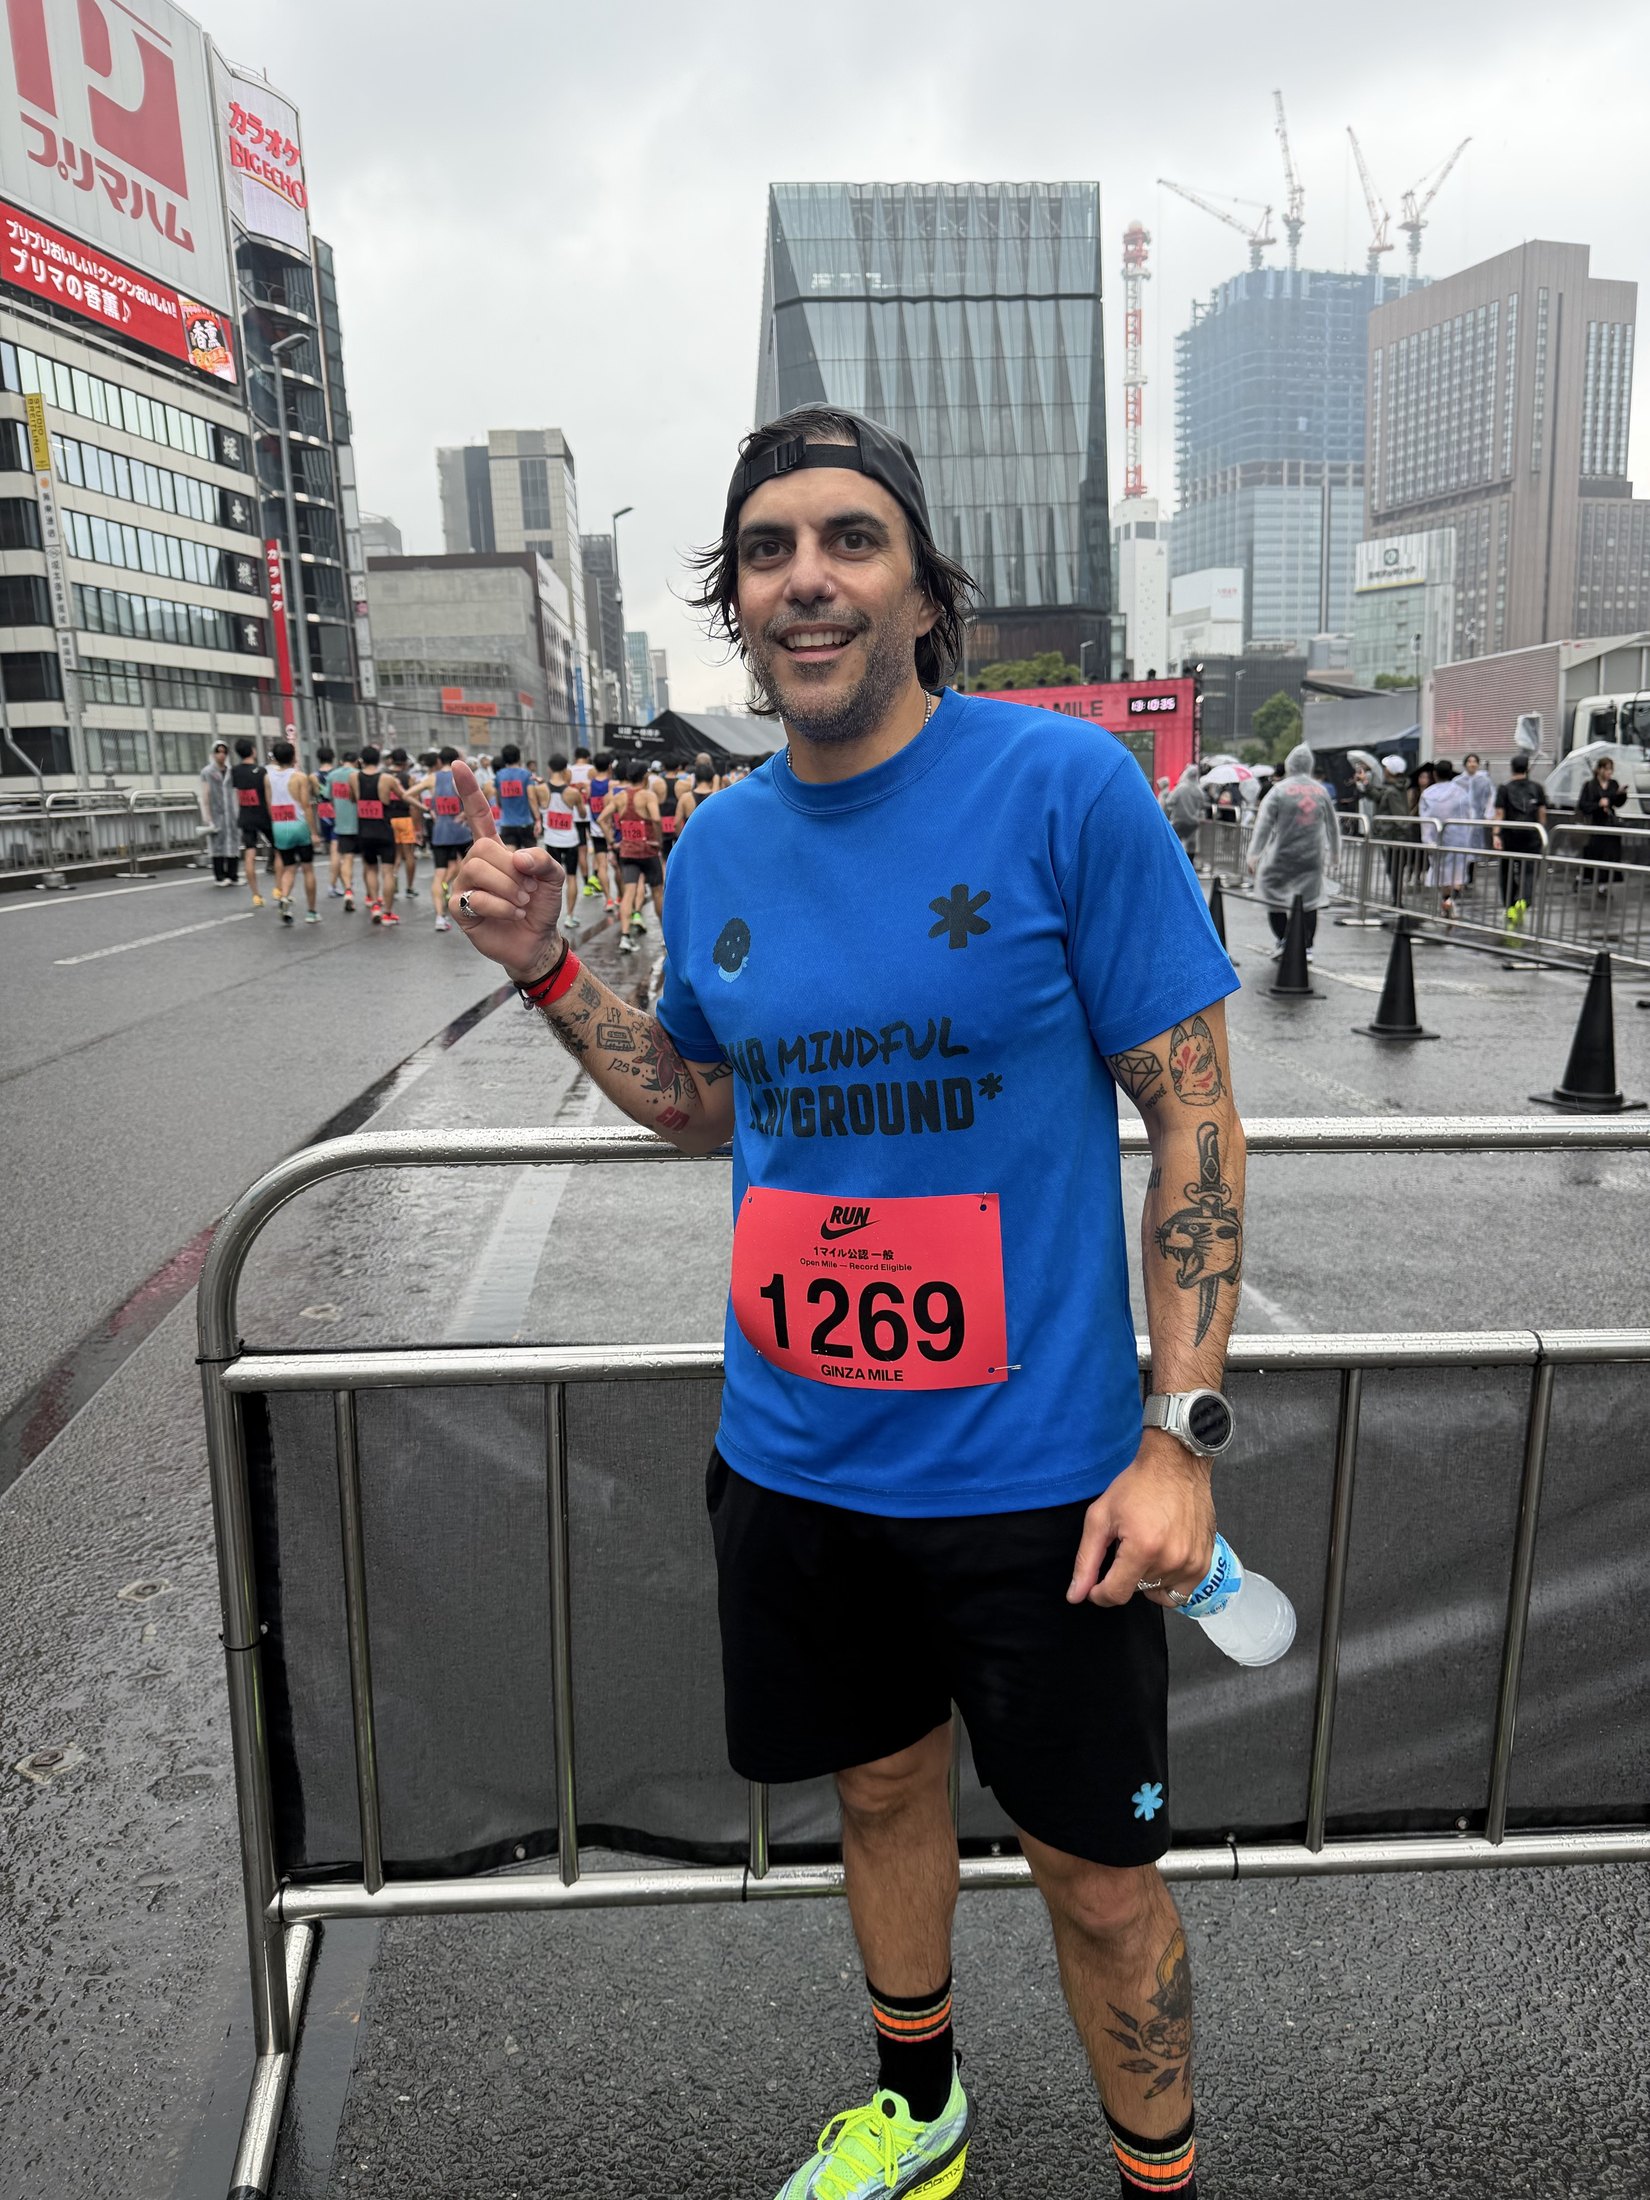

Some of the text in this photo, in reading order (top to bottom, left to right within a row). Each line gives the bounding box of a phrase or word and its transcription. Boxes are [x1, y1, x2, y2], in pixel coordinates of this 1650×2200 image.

[228, 101, 301, 167] カラオケ
[20, 111, 196, 254] プリマハム
[229, 135, 308, 209] BIG ECHO
[27, 398, 40, 453] BREITLING
[33, 398, 44, 436] STUDIO
[267, 548, 283, 612] カラオケ
[1054, 699, 1104, 718] MILE
[777, 1016, 970, 1078] MINDFUL
[829, 1205, 871, 1227] RUN
[800, 1257, 820, 1267] Open
[821, 1260, 838, 1268] Mile
[849, 1262, 879, 1271] Record
[880, 1263, 912, 1273] Eligible
[813, 1246, 895, 1261] 1マイル公認 一般
[760, 1273, 966, 1362] 1269
[820, 1364, 904, 1382] GINZA MILE
